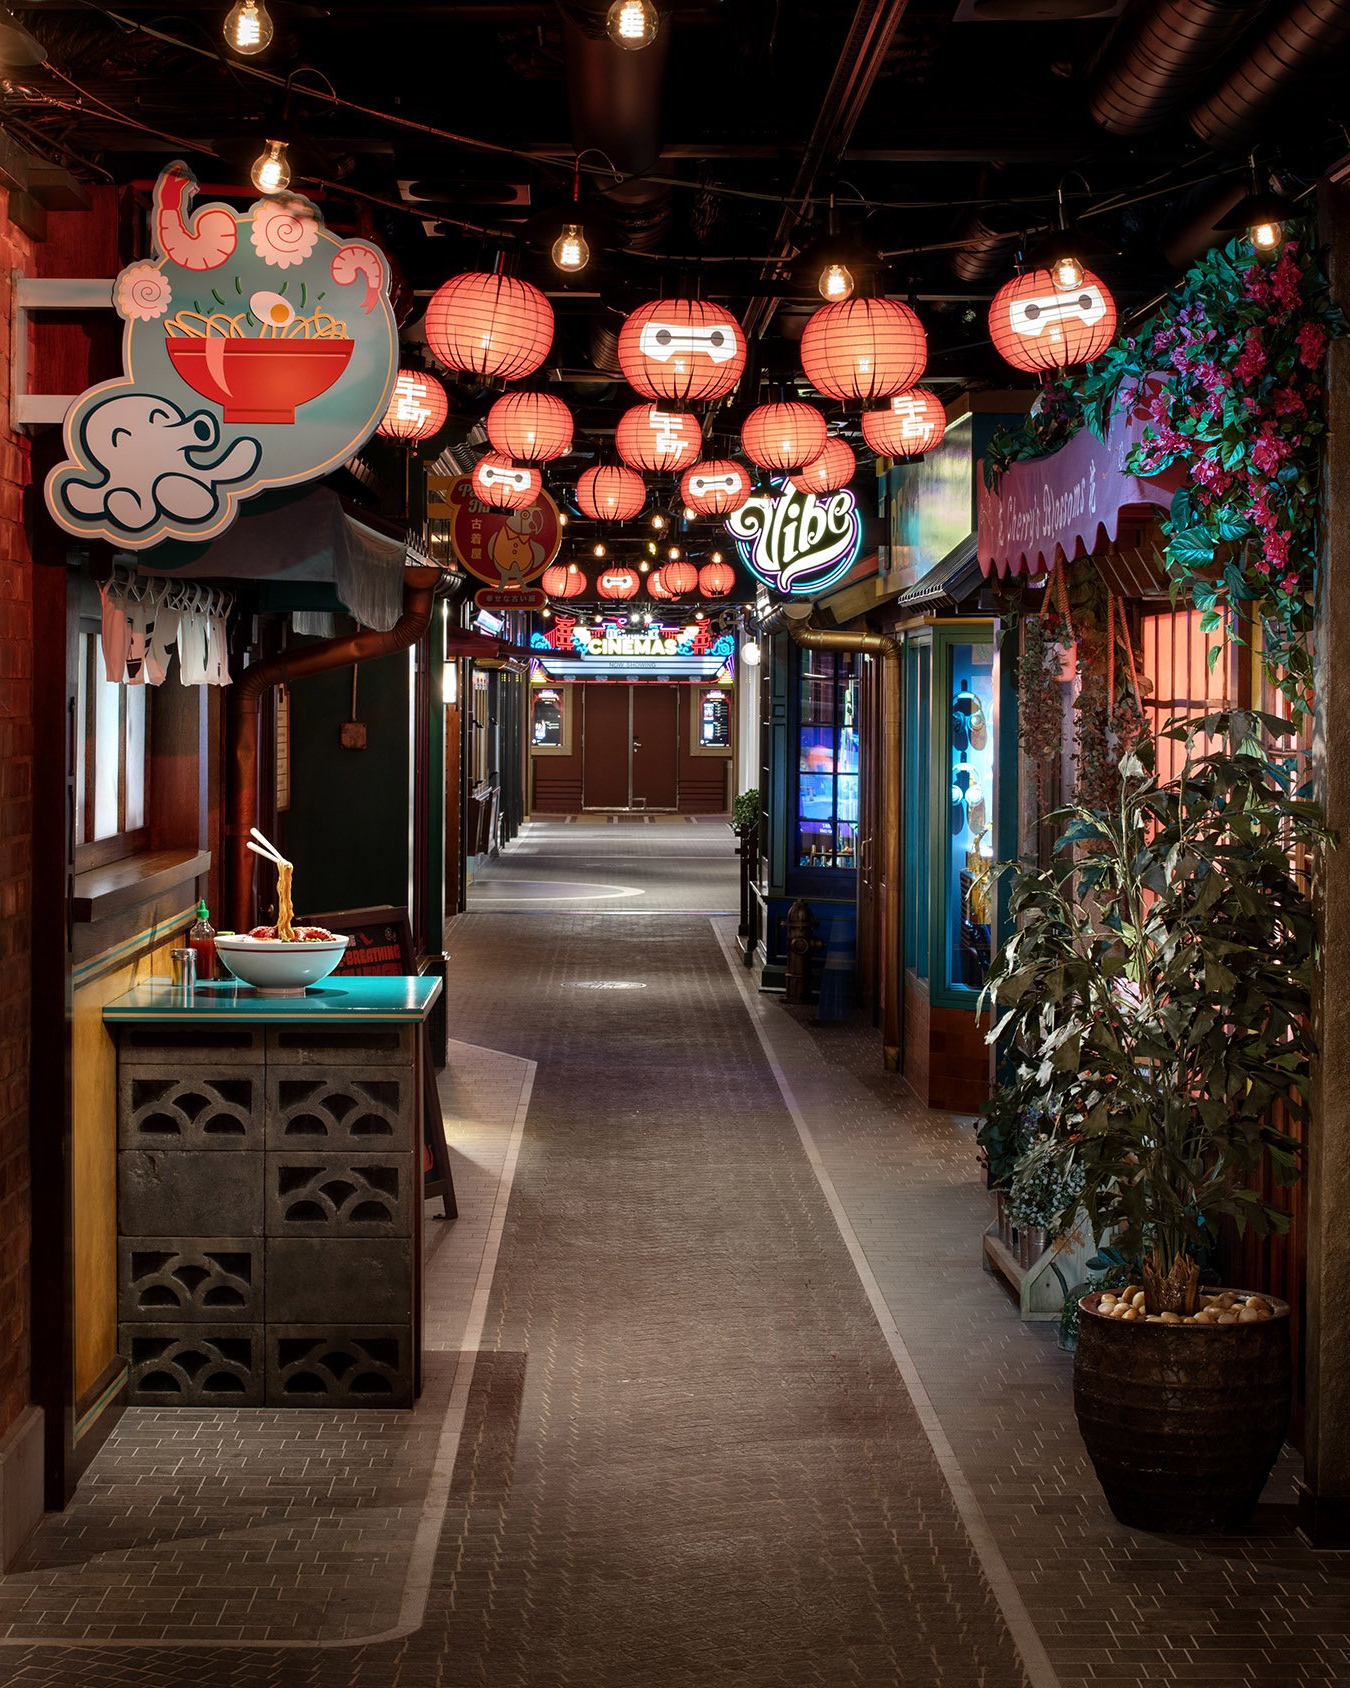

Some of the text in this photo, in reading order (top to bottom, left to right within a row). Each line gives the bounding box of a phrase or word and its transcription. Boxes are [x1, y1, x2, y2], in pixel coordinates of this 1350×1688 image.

[730, 481, 851, 589] Vibe
[1007, 493, 1040, 549] Cherry's
[1042, 478, 1086, 539] Blossoms
[588, 638, 678, 655] CINEMAS
